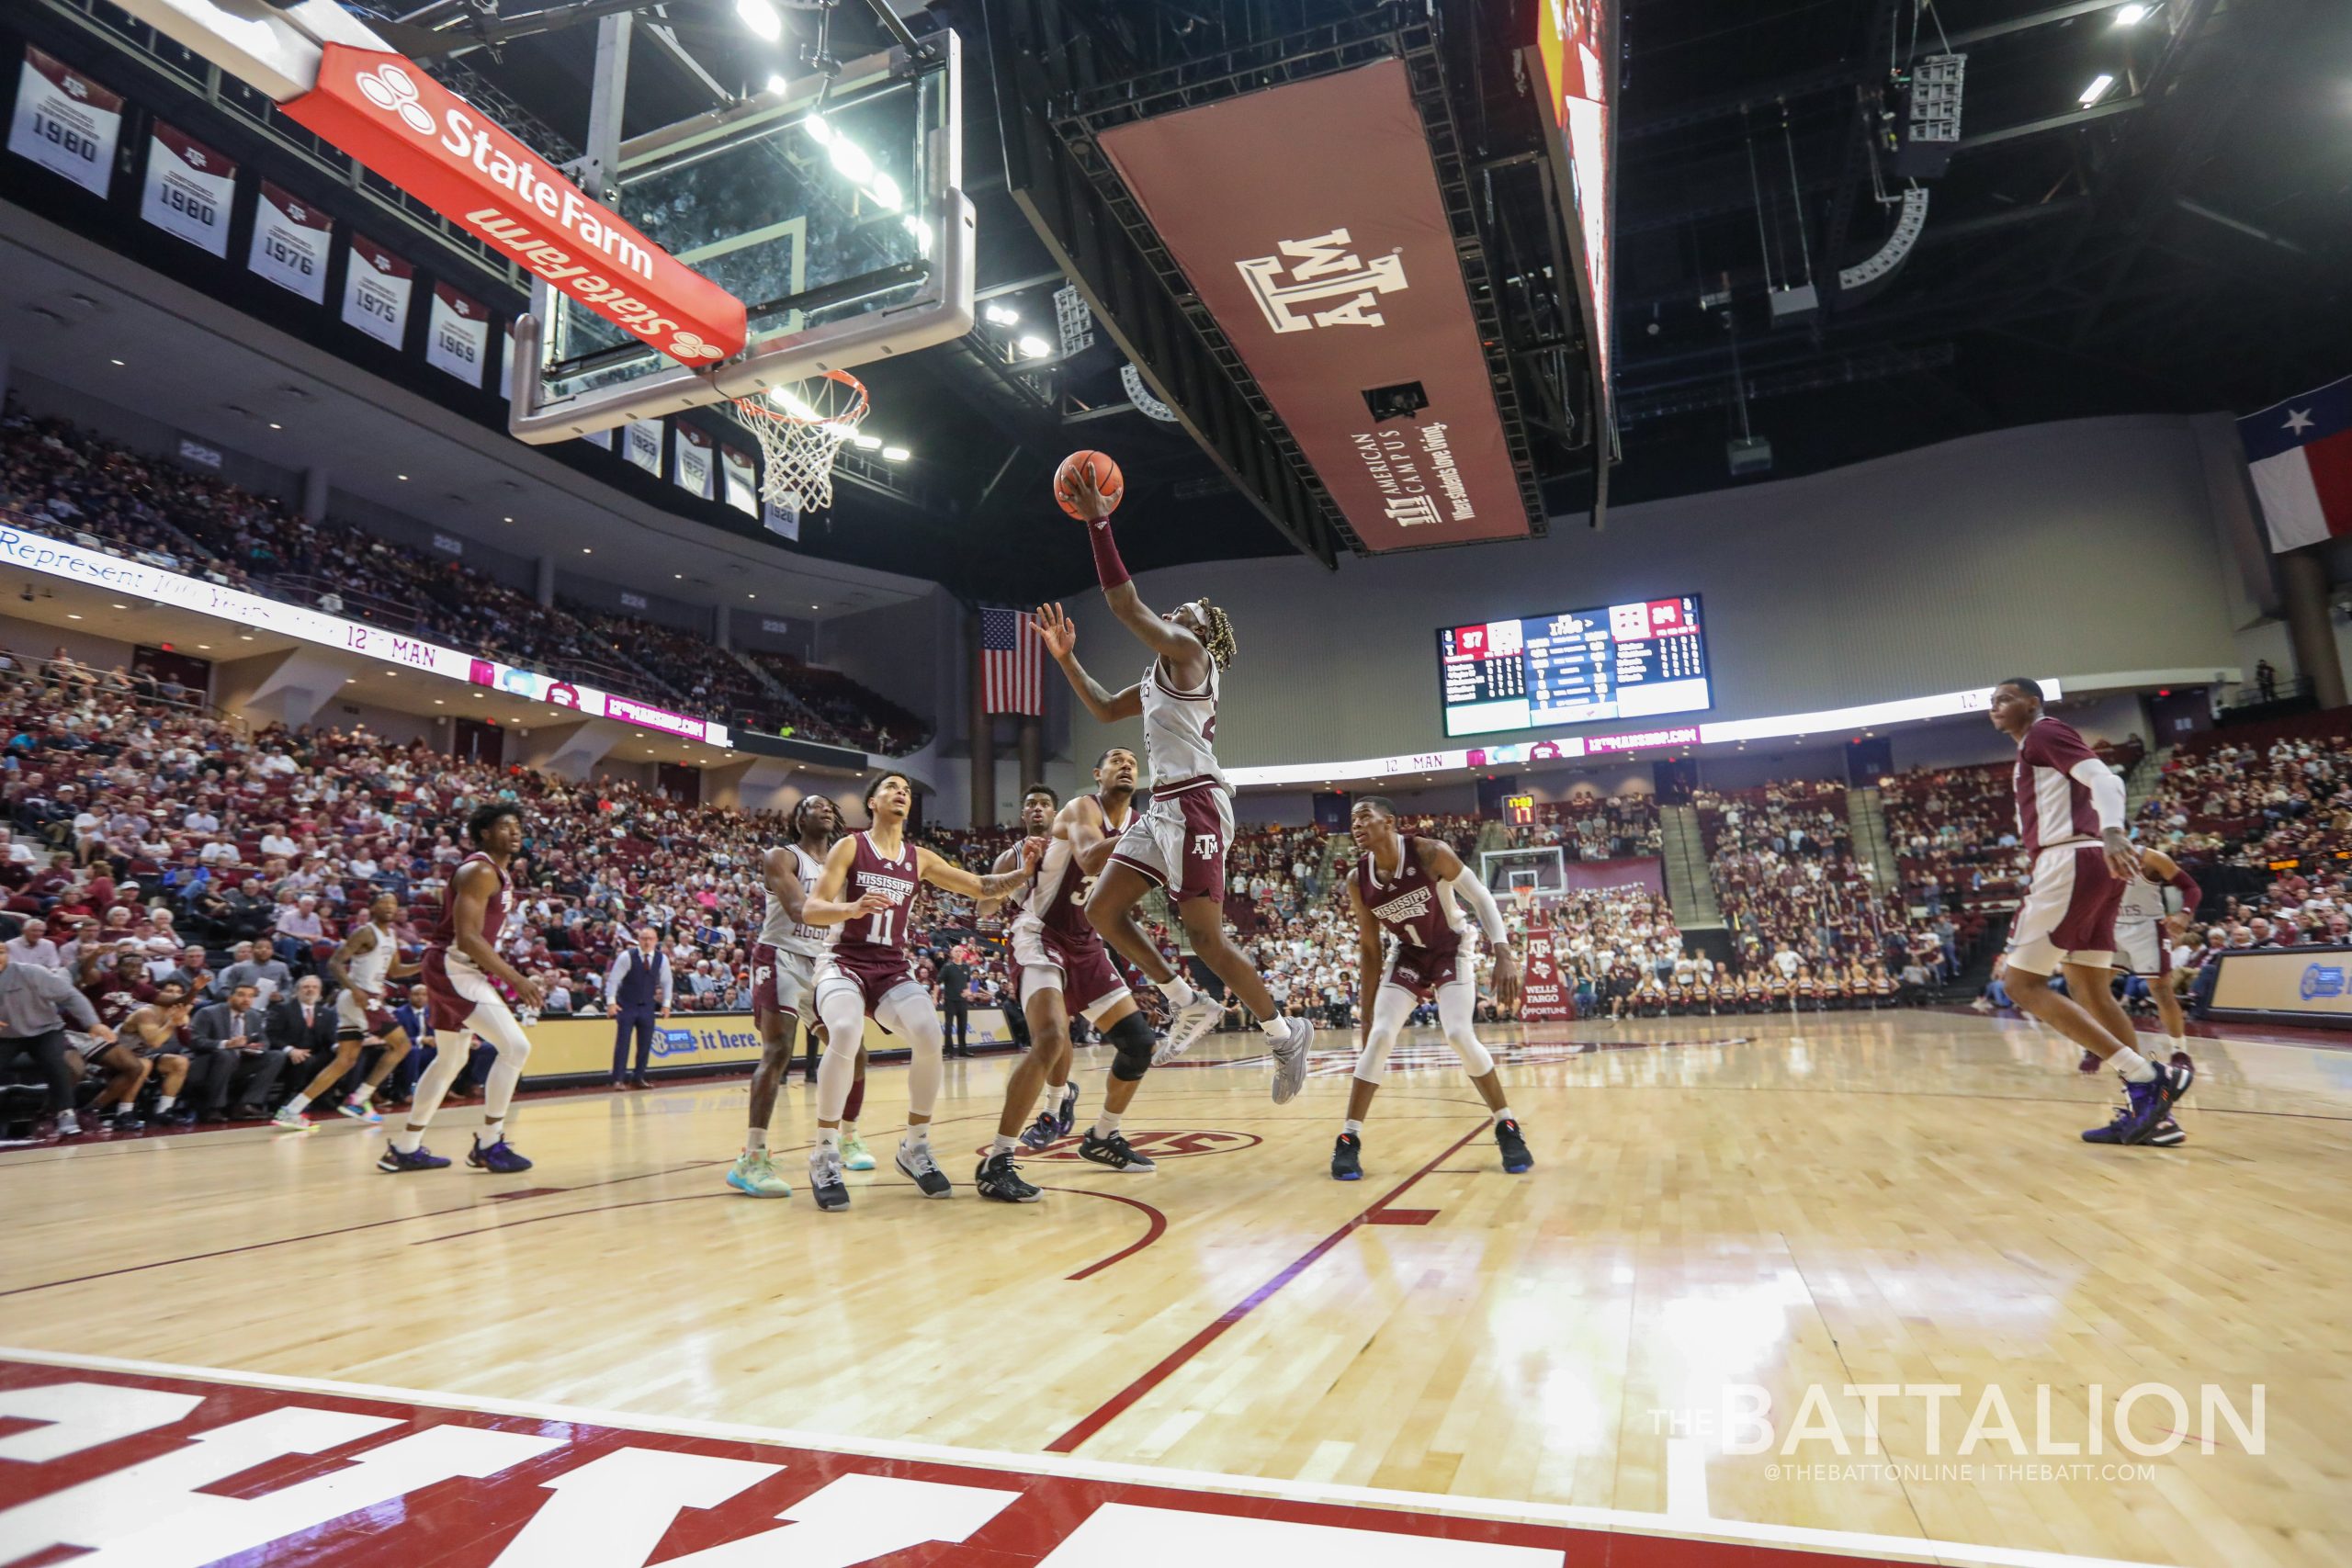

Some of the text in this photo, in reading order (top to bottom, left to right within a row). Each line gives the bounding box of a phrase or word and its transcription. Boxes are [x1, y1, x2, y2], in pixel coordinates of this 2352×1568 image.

[33, 111, 97, 163] 1980
[161, 183, 215, 227] 1980
[266, 236, 314, 276] 1976
[356, 288, 398, 323] 1975
[439, 331, 475, 363] 1969
[631, 431, 657, 457] 1923
[1351, 434, 1402, 495] AMERICAN
[1378, 430, 1426, 493] CAMPUS
[1430, 449, 1455, 470] love
[1436, 468, 1468, 500] students
[1452, 498, 1476, 522] Where
[391, 637, 435, 668] MAN
[1413, 754, 1442, 770] MAN
[856, 873, 914, 895] MISSISSIPPI
[1372, 887, 1431, 919] MISSISSIPPI
[1393, 907, 1420, 921] STATE
[792, 922, 831, 941] AGGI
[865, 907, 894, 946] 11
[1404, 924, 1427, 948] 1
[1525, 984, 1558, 994] WELLS
[1527, 994, 1559, 1003] FARGO
[1521, 1004, 1567, 1019] OPPORTUNE
[699, 1030, 717, 1049] it
[718, 1029, 762, 1049] here.
